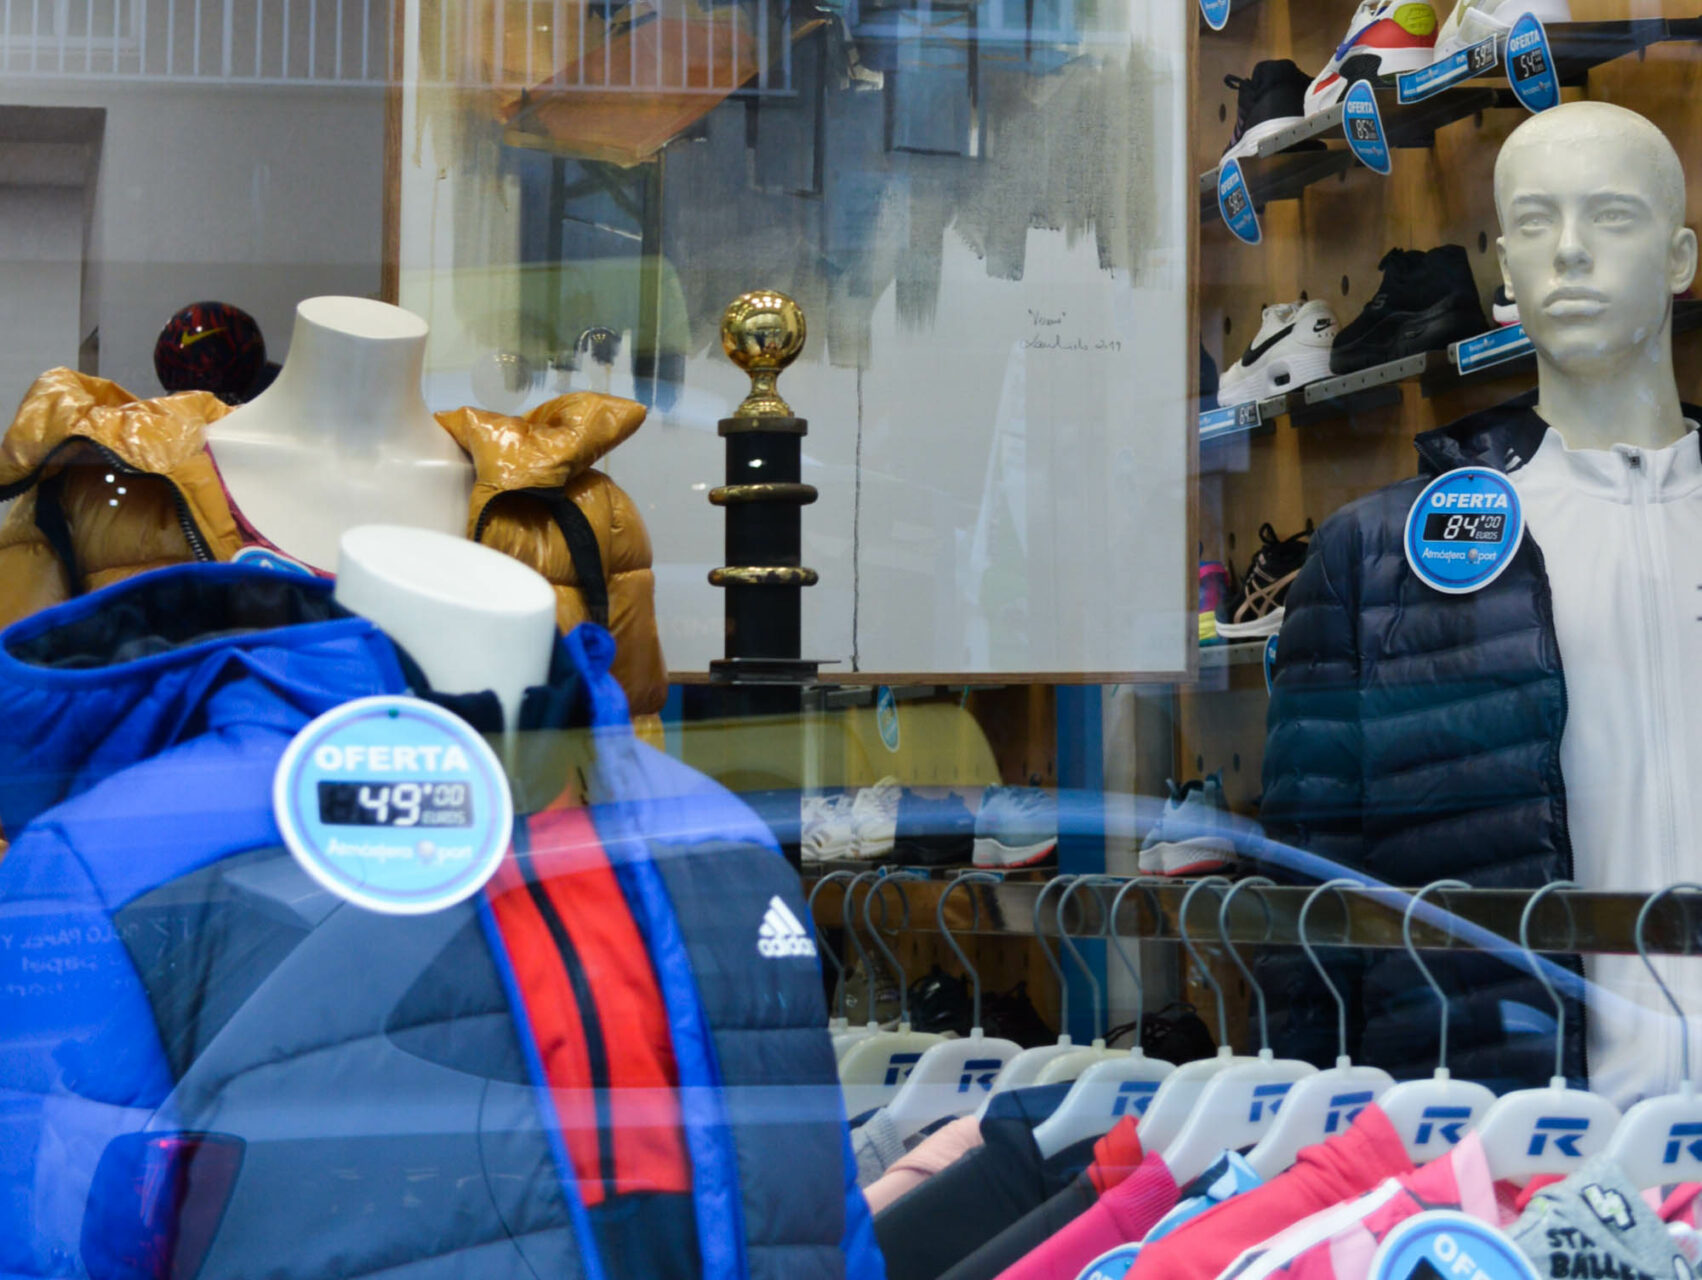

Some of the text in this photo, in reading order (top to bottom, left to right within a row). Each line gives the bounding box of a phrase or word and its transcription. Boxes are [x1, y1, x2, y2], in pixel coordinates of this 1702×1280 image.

[1509, 29, 1541, 52] OFERTA
[1347, 101, 1374, 114] OFERTA
[1431, 493, 1508, 509] OFERTA
[314, 745, 469, 771] OFERTA
[1550, 1250, 1655, 1280] BALLE
